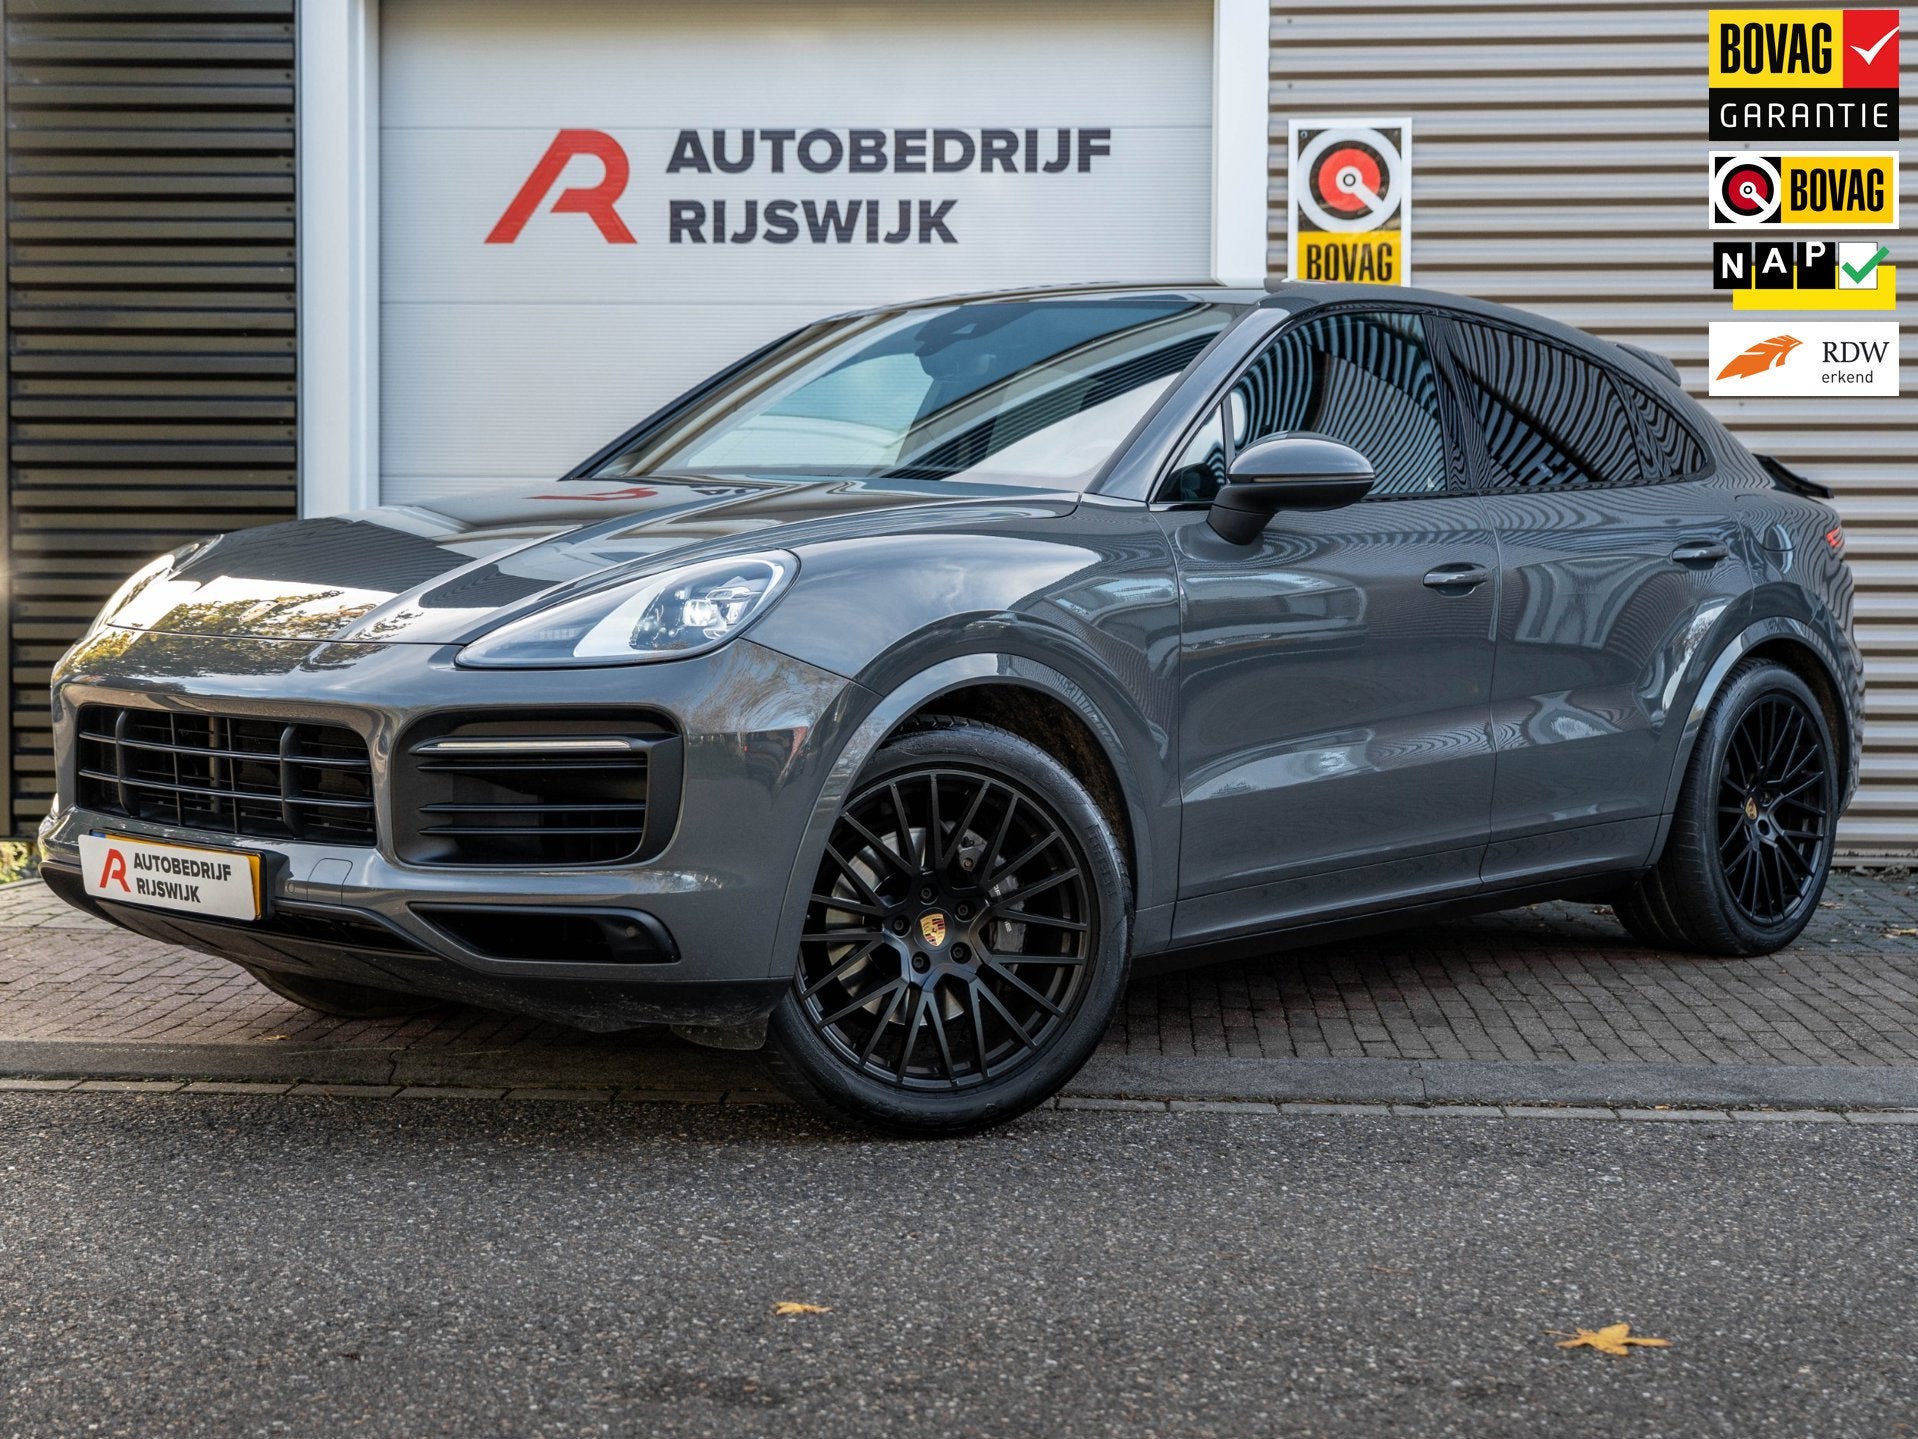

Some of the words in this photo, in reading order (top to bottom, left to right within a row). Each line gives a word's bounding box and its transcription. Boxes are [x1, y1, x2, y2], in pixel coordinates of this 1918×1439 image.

[666, 128, 1111, 174] AUTOBEDRIJF
[668, 199, 959, 244] RIJSWIJK
[1306, 243, 1392, 281] BOVAG
[133, 853, 231, 881] AUTOBEDRIJF
[136, 878, 201, 903] RIJSWIJK
